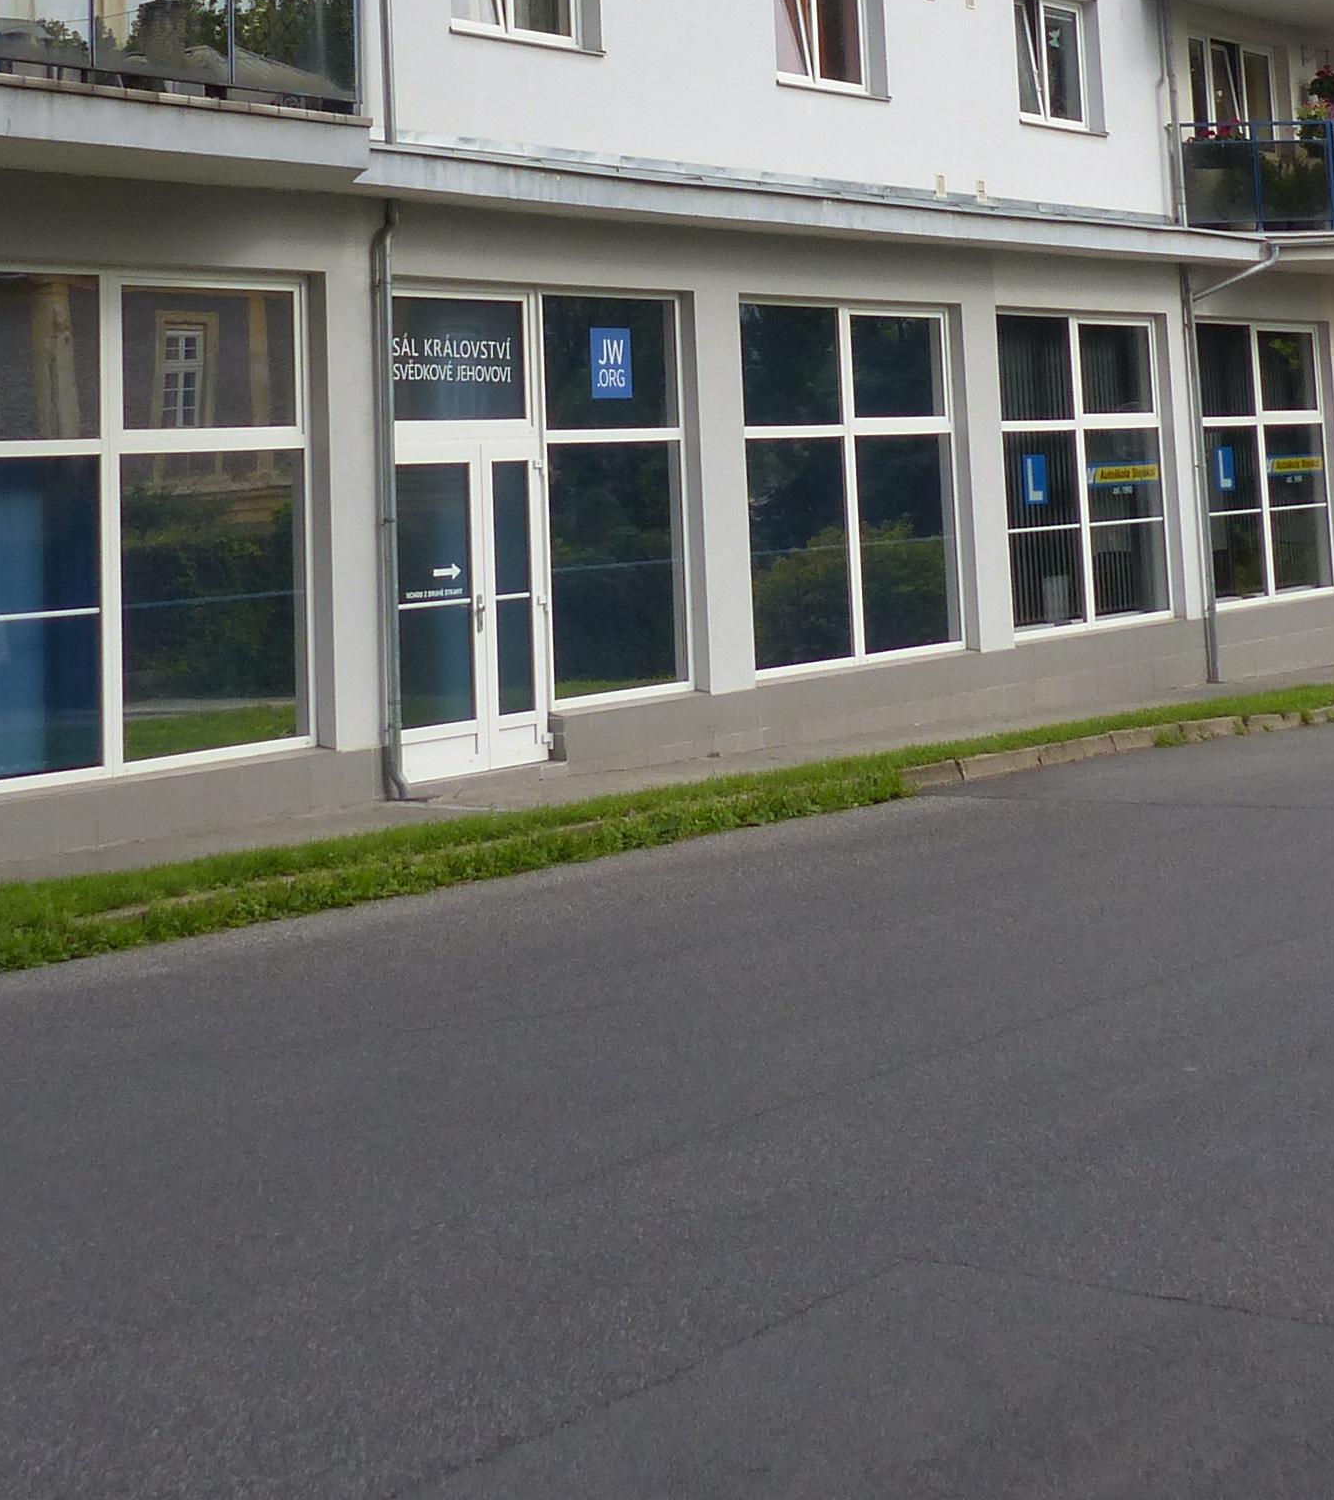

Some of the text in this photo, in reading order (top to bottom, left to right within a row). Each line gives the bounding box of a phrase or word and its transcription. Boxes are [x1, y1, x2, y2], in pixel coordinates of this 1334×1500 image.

[392, 332, 511, 360] SÁL KRÁLOVSTVÍ
[598, 338, 624, 366] JW
[393, 359, 512, 383] SVĚDKOVÉ JEHOVOVI
[597, 368, 626, 388] .ORG
[1026, 457, 1044, 501] L
[1218, 449, 1232, 488] L
